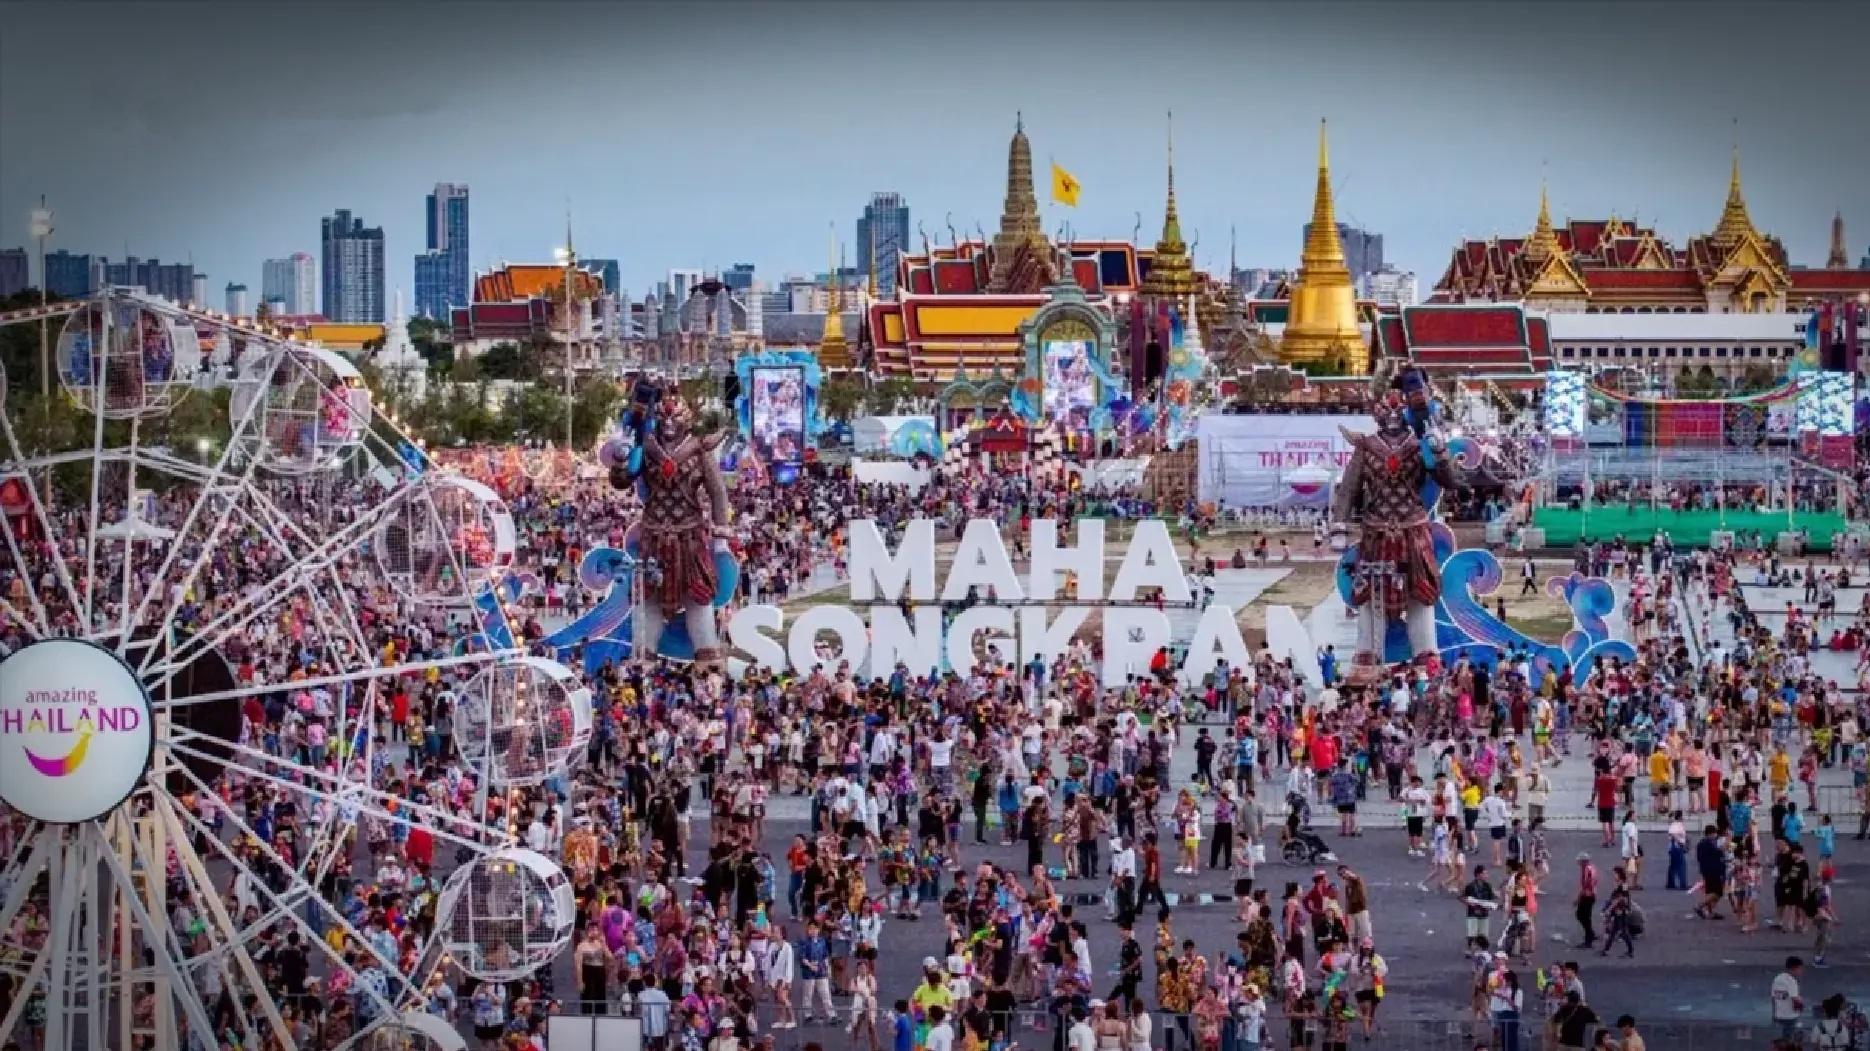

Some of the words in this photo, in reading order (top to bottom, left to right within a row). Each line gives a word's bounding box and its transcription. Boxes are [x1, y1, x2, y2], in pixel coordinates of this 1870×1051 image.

[849, 519, 1192, 600] MAHA
[25, 686, 98, 705] amazing
[0, 707, 140, 733] HAILAND
